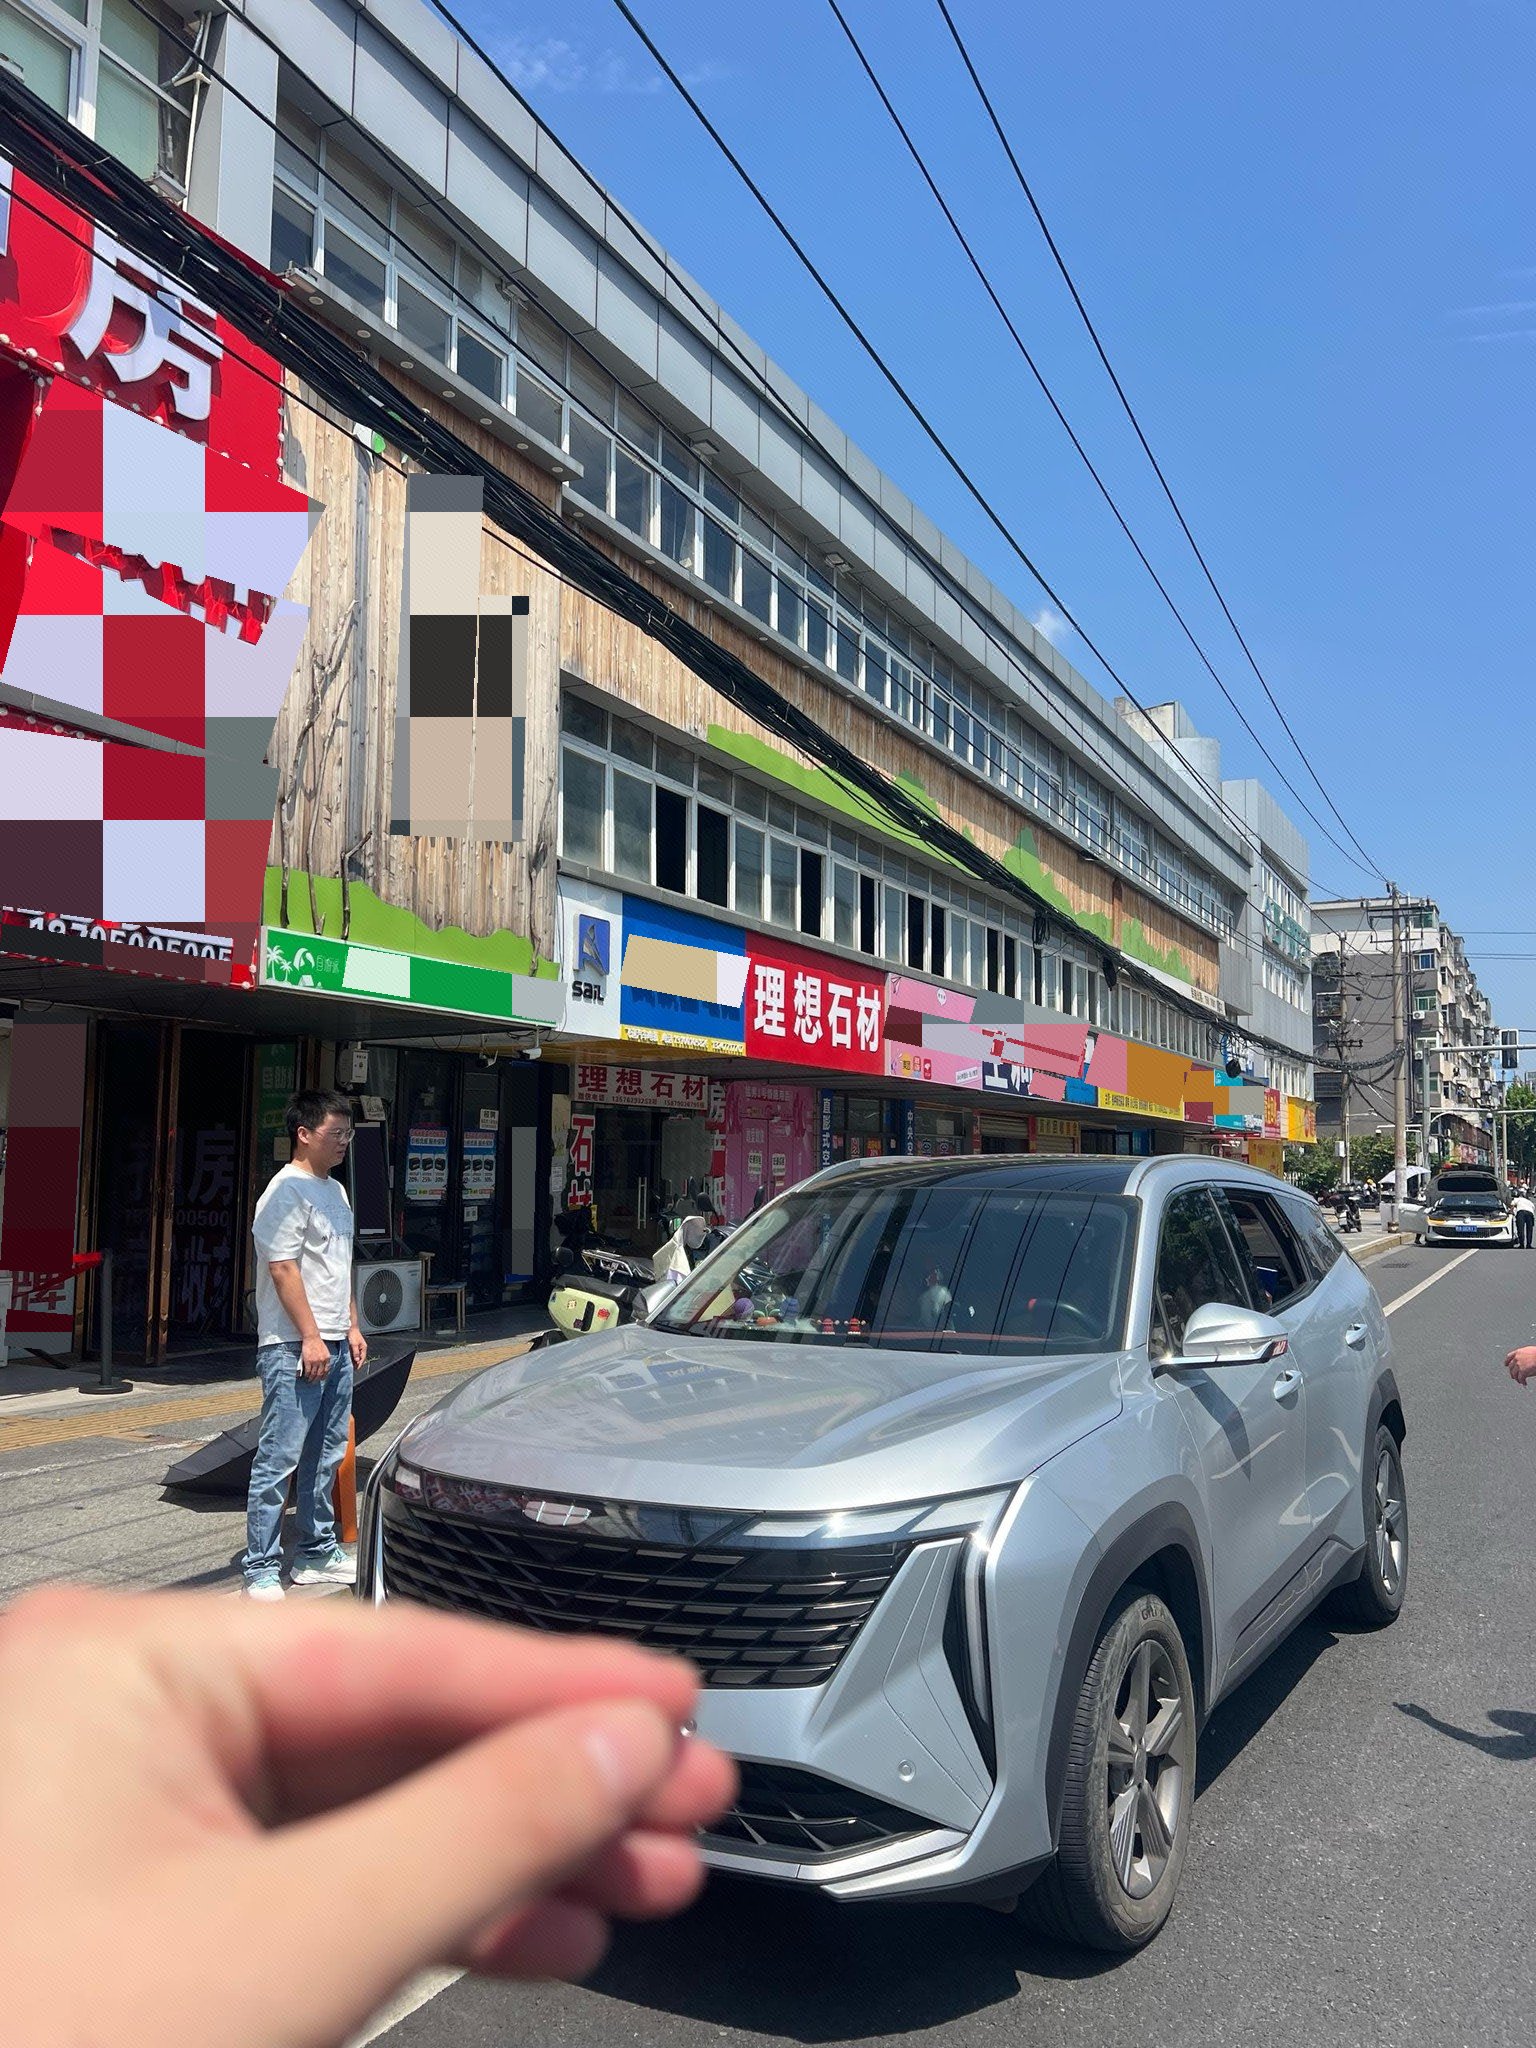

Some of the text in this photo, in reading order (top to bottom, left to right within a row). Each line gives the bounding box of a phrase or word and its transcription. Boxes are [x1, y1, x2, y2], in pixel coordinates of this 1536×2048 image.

[754, 964, 881, 1053] 理想石材
[578, 1064, 706, 1101] 理想石材
